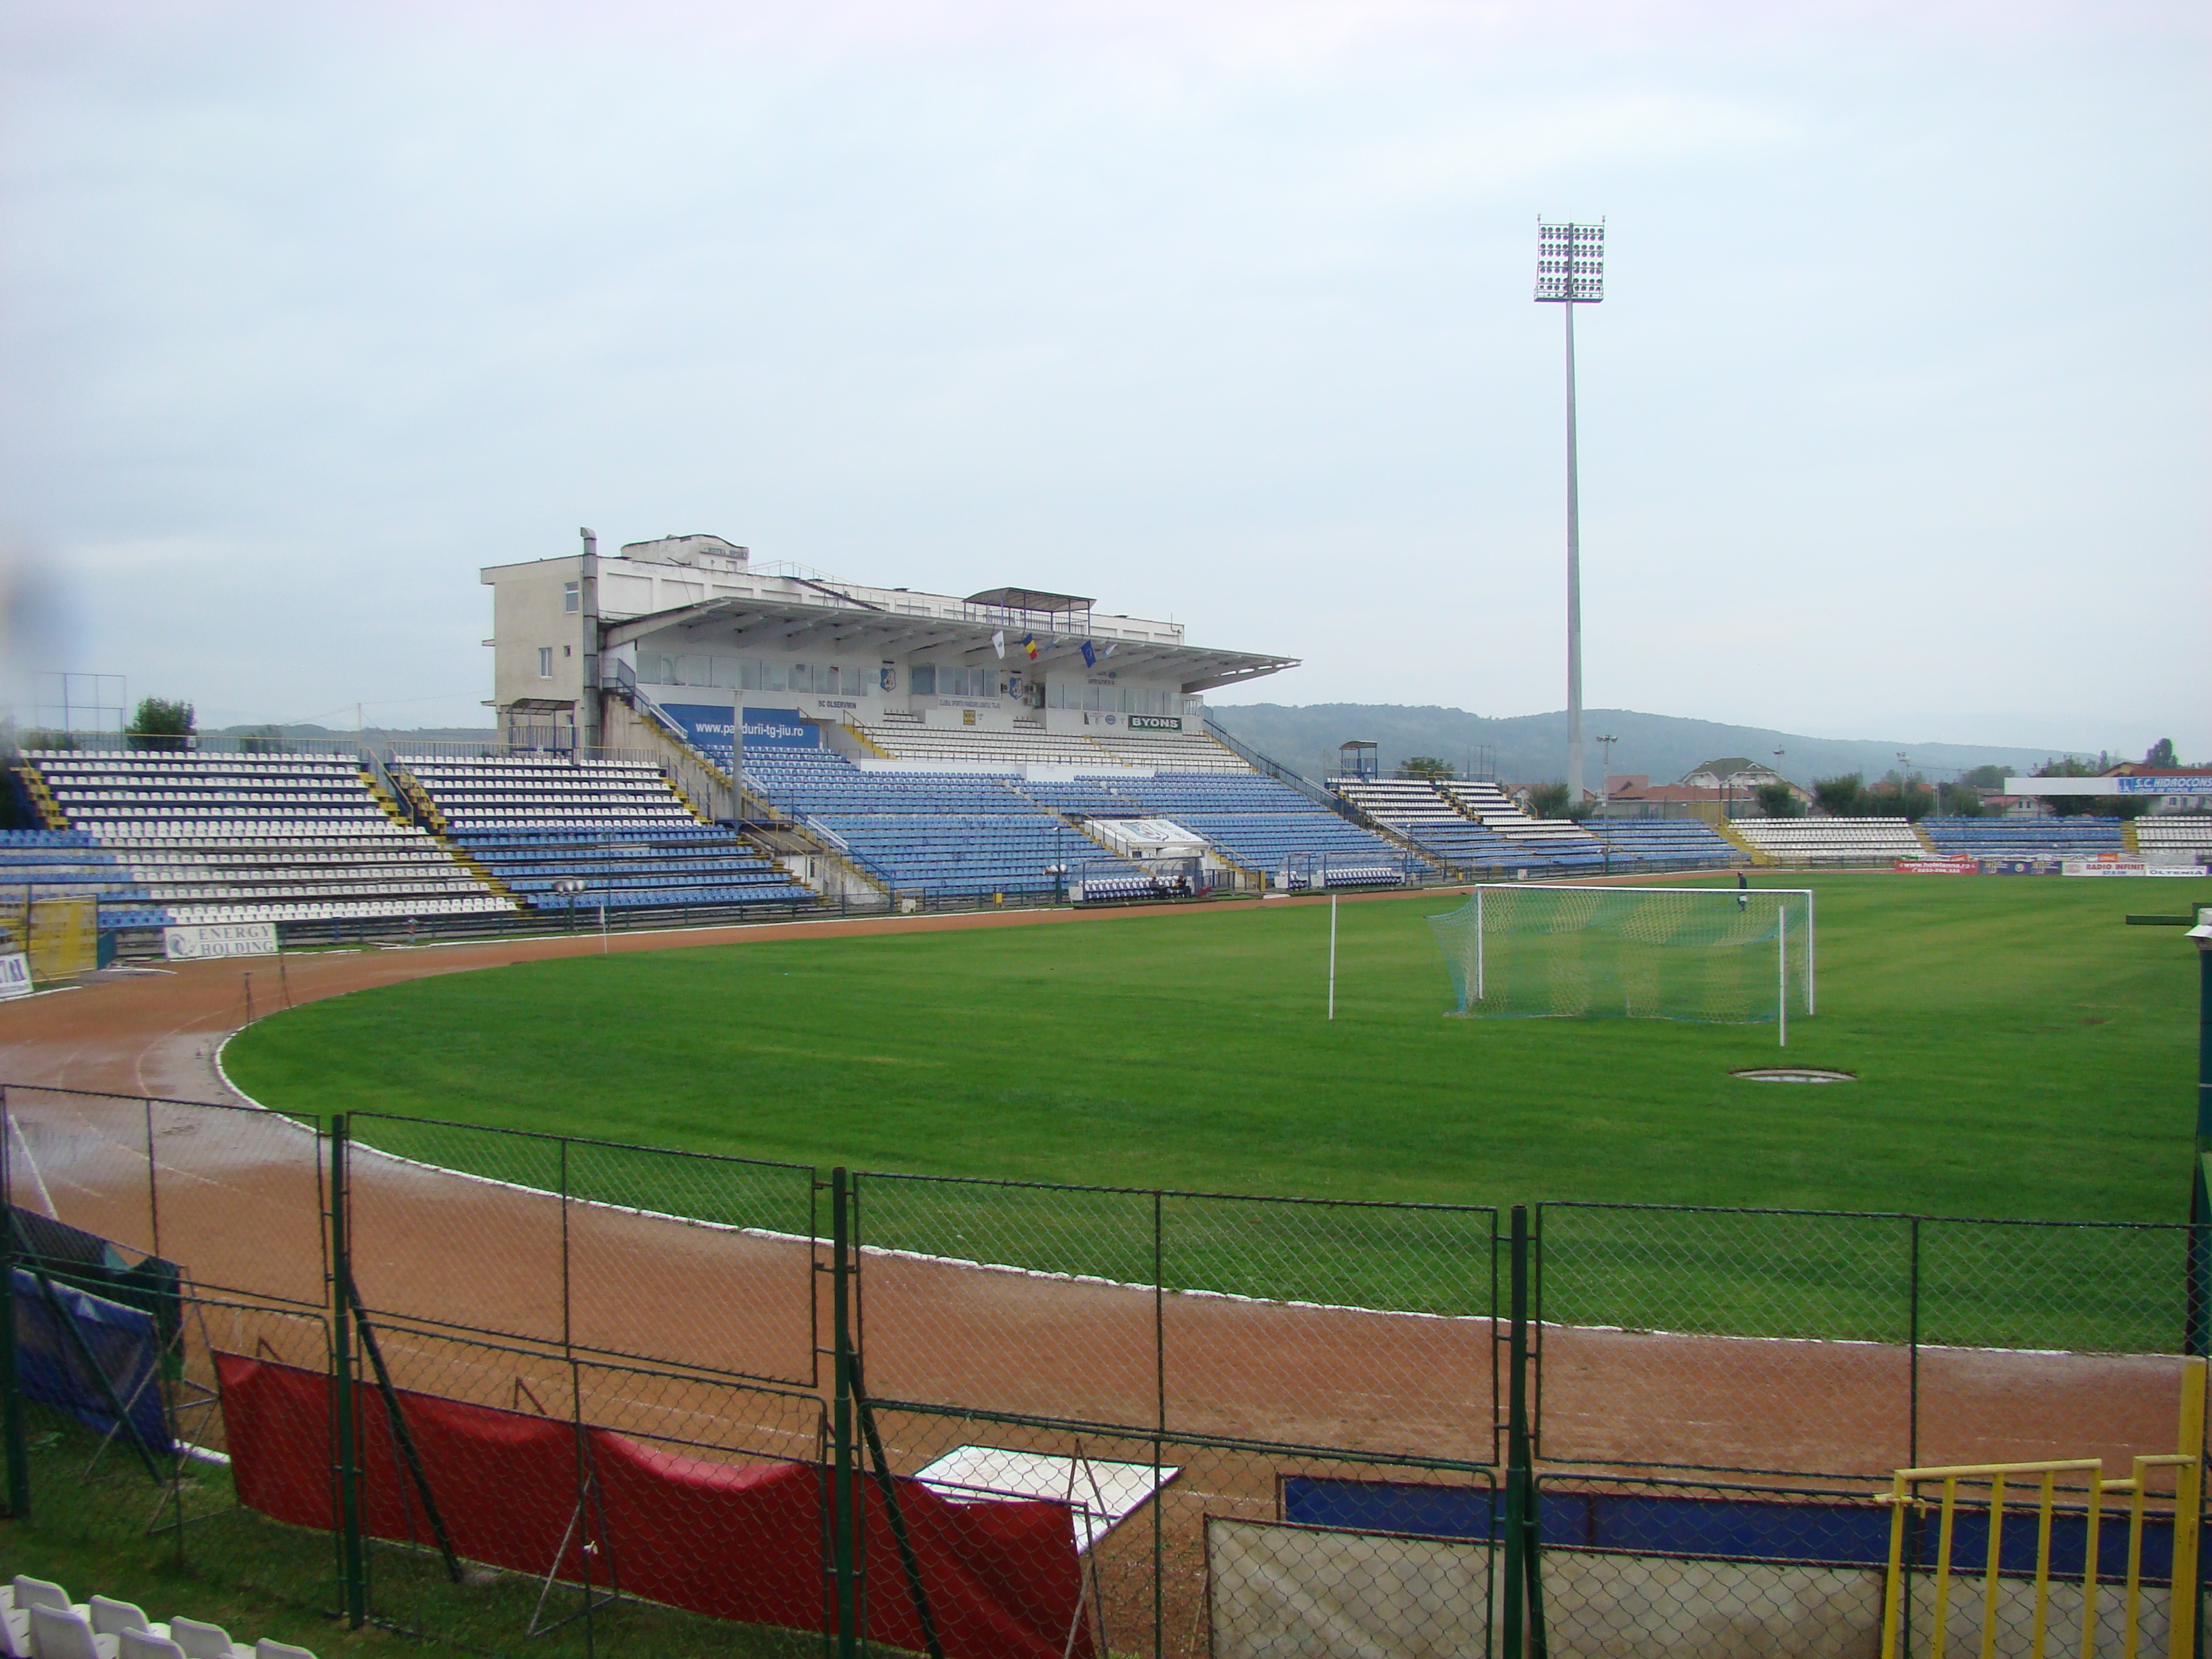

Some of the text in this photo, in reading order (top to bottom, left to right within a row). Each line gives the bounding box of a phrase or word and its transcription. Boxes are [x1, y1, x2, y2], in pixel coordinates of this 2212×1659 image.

[1132, 717, 1179, 729] BYONS
[695, 722, 804, 739] www.padurii-tg-jiu.ro
[199, 926, 271, 940] ENERGY
[201, 941, 274, 956] HOLDING
